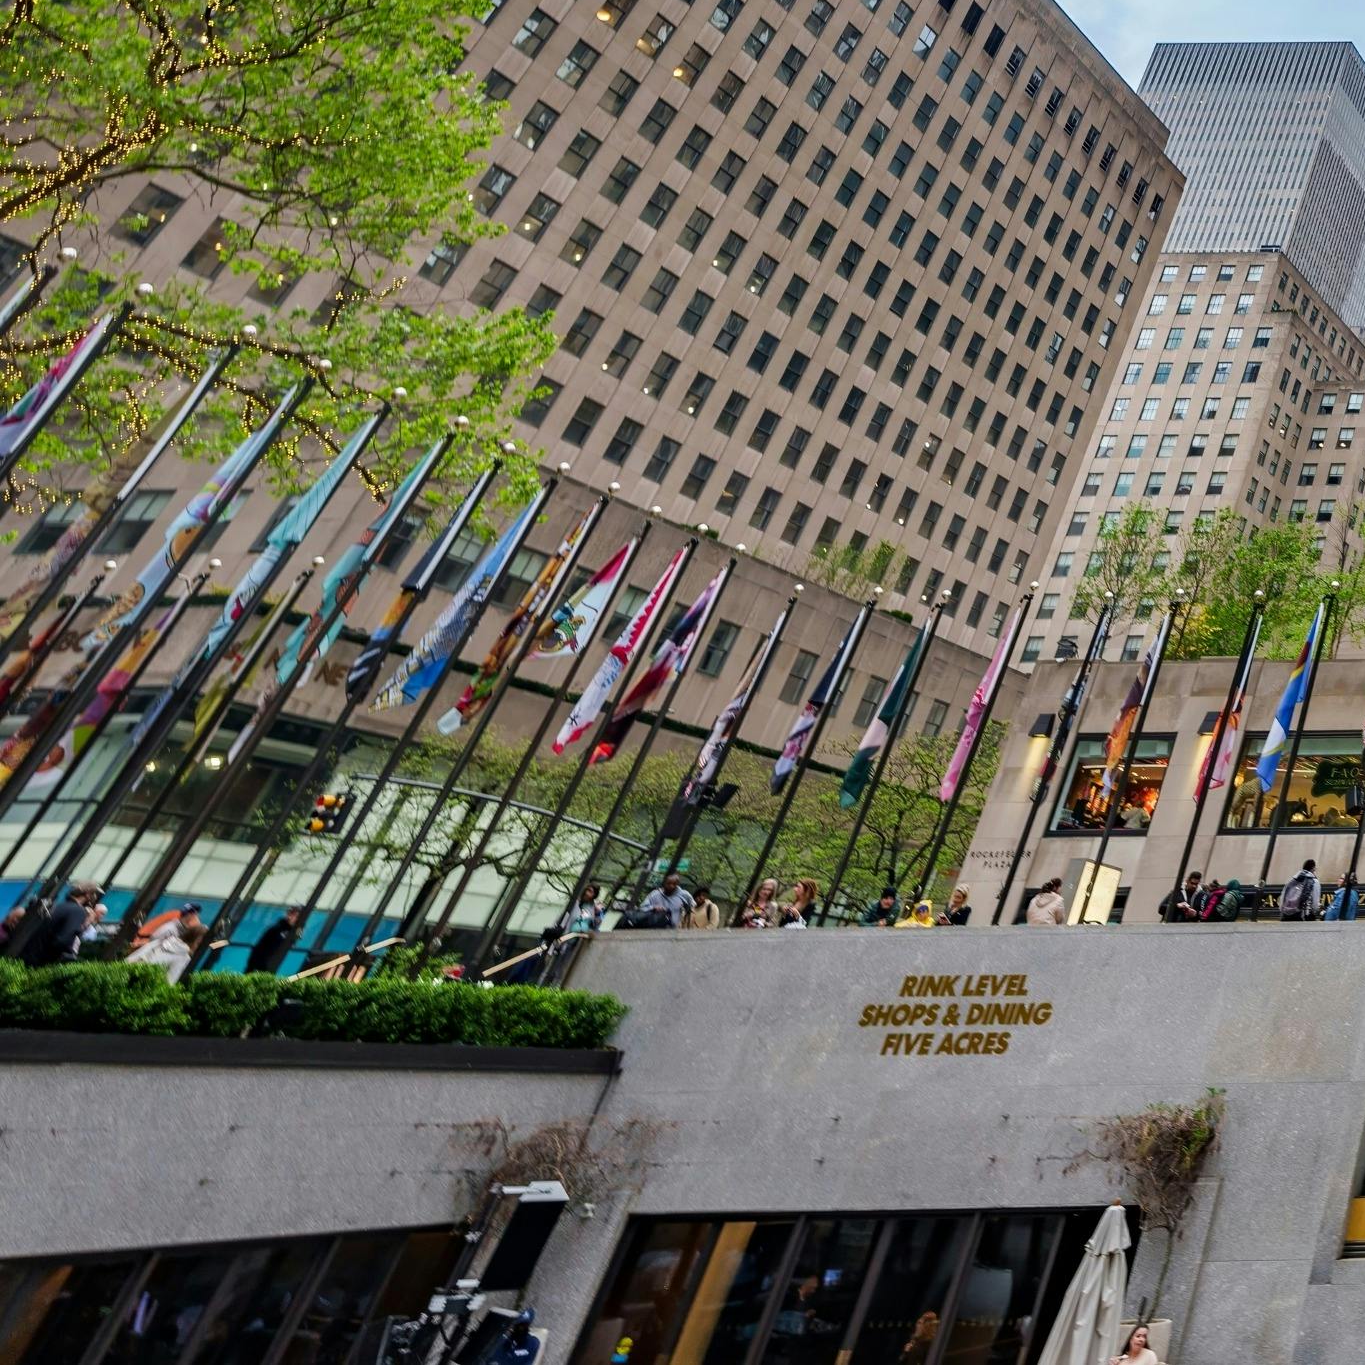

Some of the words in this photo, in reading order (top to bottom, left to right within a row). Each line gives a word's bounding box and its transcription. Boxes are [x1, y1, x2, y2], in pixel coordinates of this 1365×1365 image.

[899, 975, 962, 998] RINK
[961, 974, 1029, 997] LEVEL
[858, 1003, 940, 1027] SHOPS
[941, 1003, 961, 1026] &
[964, 1002, 1053, 1026] DINING
[880, 1032, 936, 1057] FIVE
[935, 1031, 1012, 1056] ACRES
